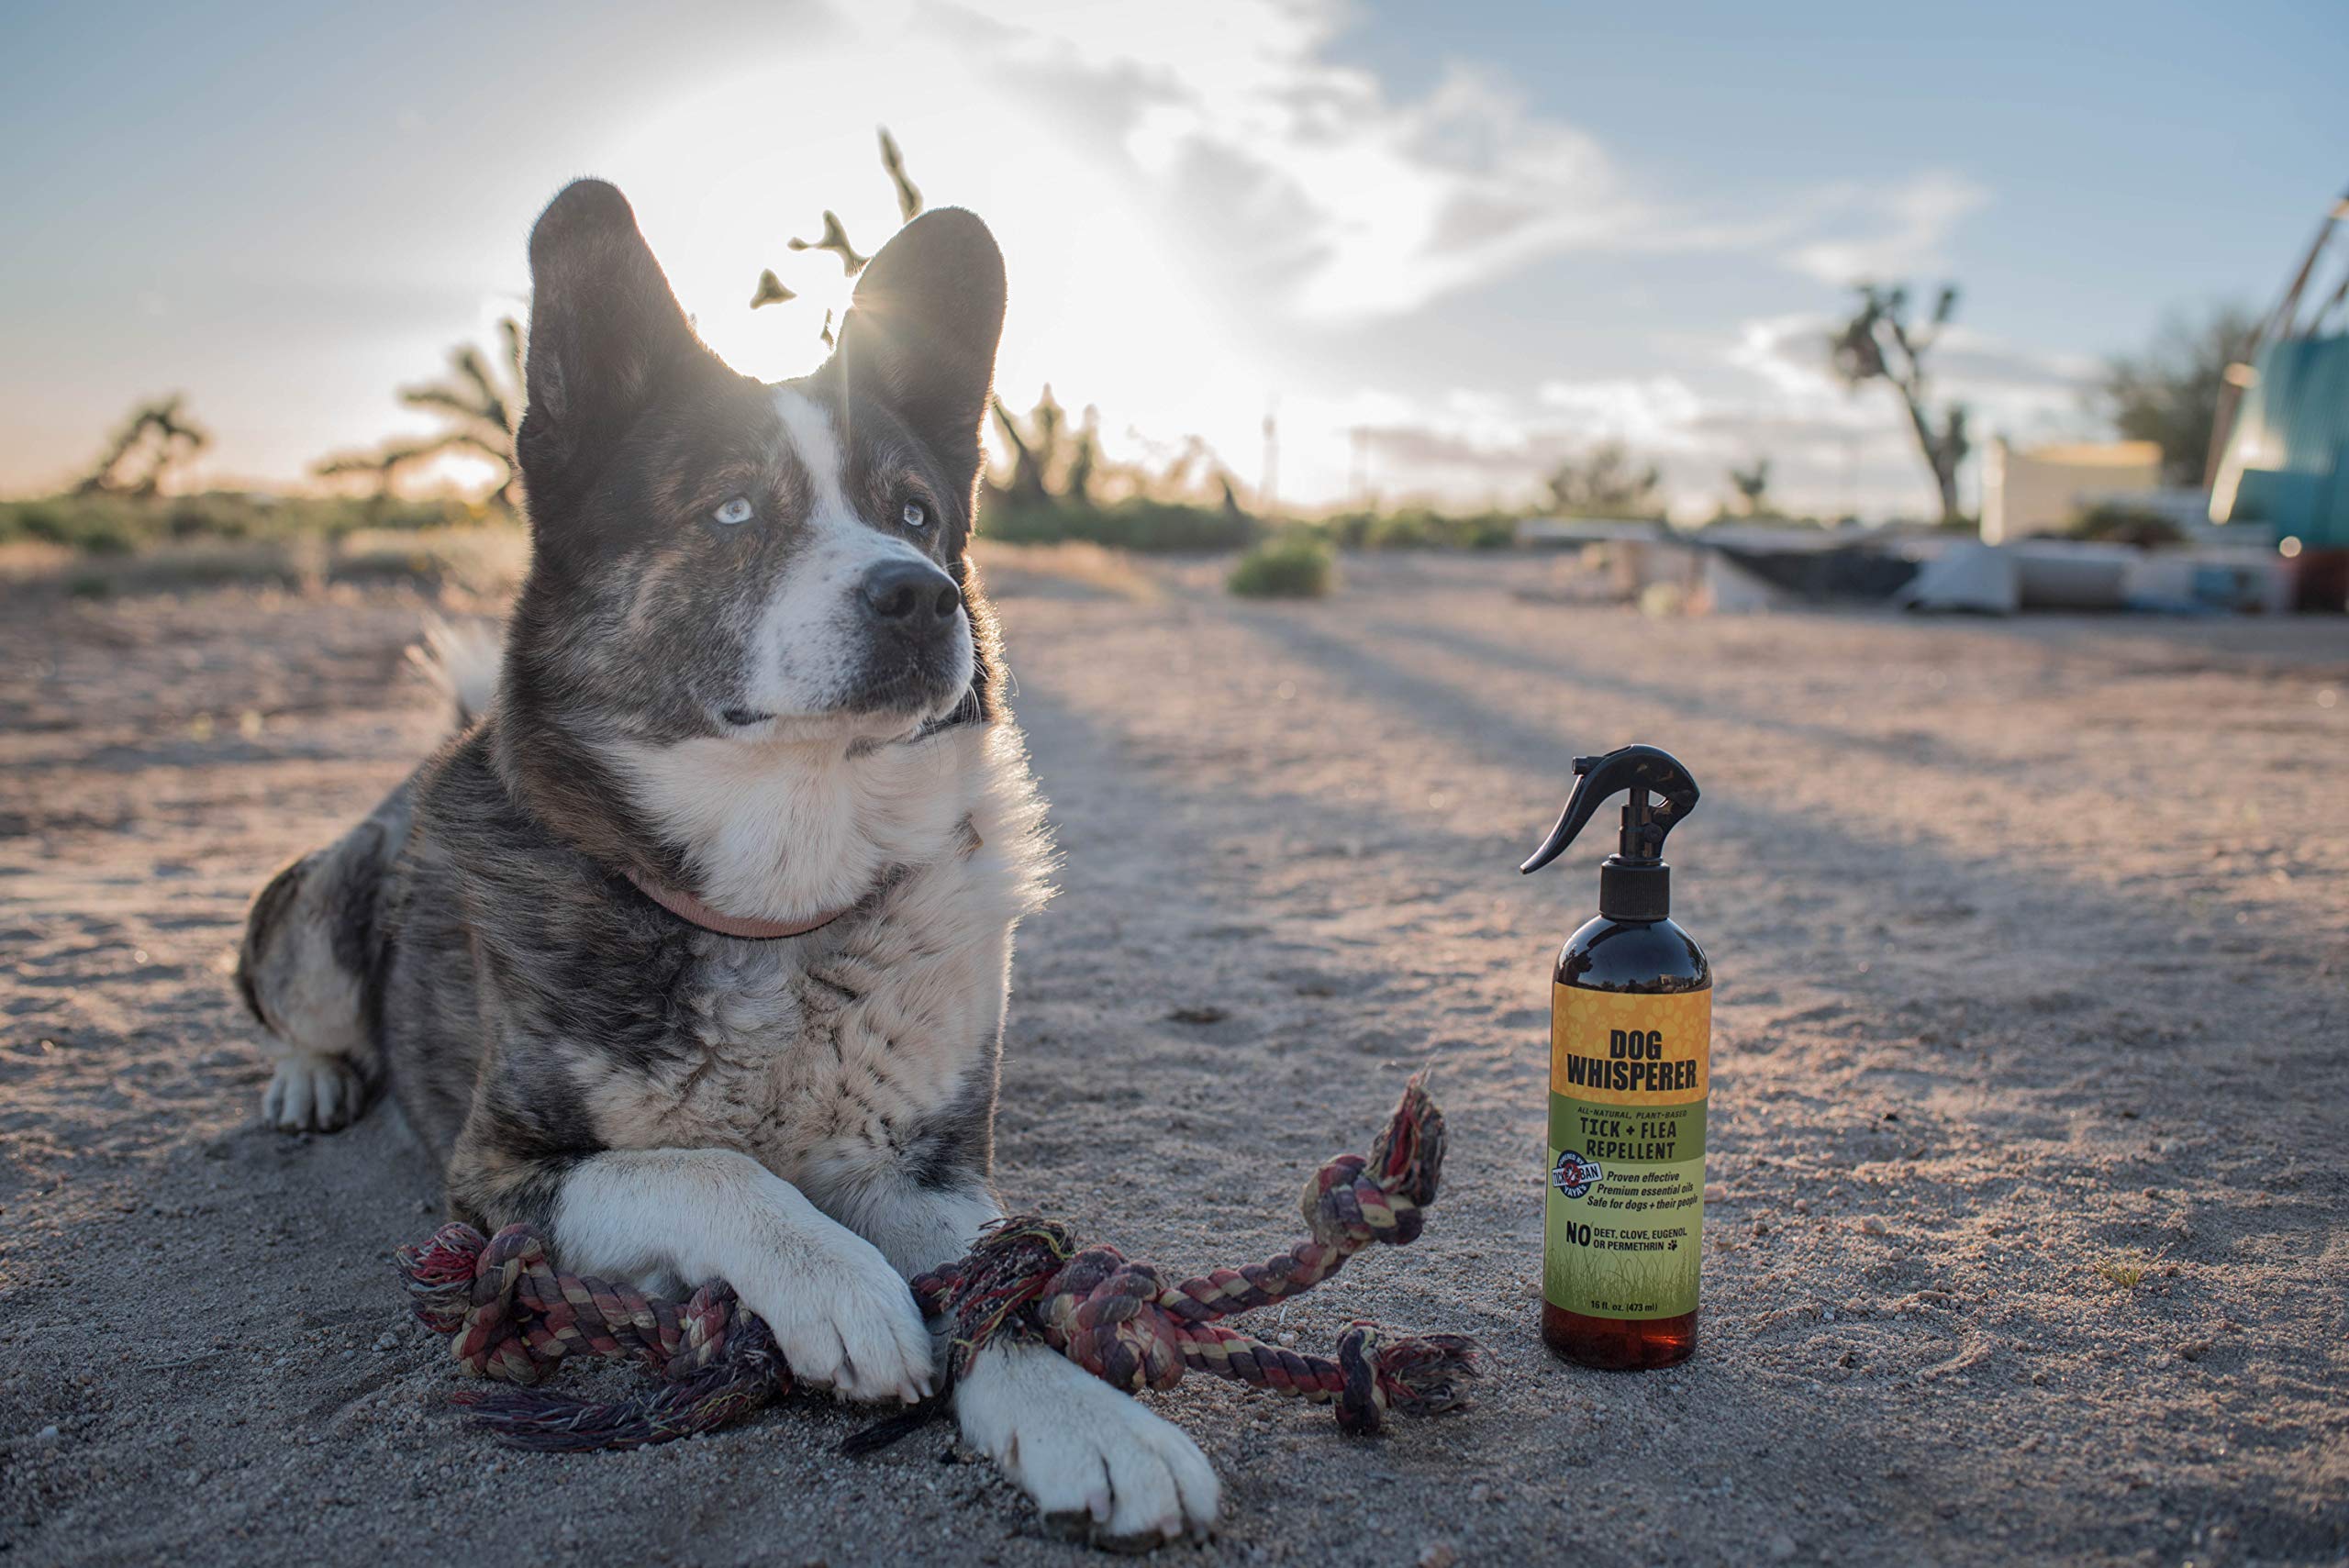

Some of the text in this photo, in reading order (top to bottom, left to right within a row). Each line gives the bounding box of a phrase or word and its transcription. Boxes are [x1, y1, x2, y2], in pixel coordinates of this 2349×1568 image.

[1610, 1029, 1662, 1060] DOG
[1567, 1053, 1698, 1092] WHISPERER
[1577, 1106, 1687, 1119] ALL-NATURAL, PLANT-BASED
[1580, 1118, 1676, 1139] TICK + FLEA
[1586, 1140, 1675, 1160] REPELLENT
[1580, 1165, 1598, 1180] BAN
[1607, 1171, 1680, 1183] Proven effective
[1597, 1182, 1694, 1196] Premium essential oils
[1586, 1195, 1608, 1208] Safe
[1609, 1200, 1623, 1209] for
[1625, 1201, 1648, 1212] dogs
[1656, 1200, 1676, 1209] their
[1677, 1195, 1698, 1209] people
[1566, 1220, 1591, 1247] NO
[1594, 1228, 1687, 1240] DEET, CLOVE, EUGENOL
[1607, 1241, 1664, 1251] PERMETHRIN
[1591, 1300, 1600, 1309] 16
[1626, 1303, 1643, 1312] (473
[1644, 1303, 1658, 1311] ml)
